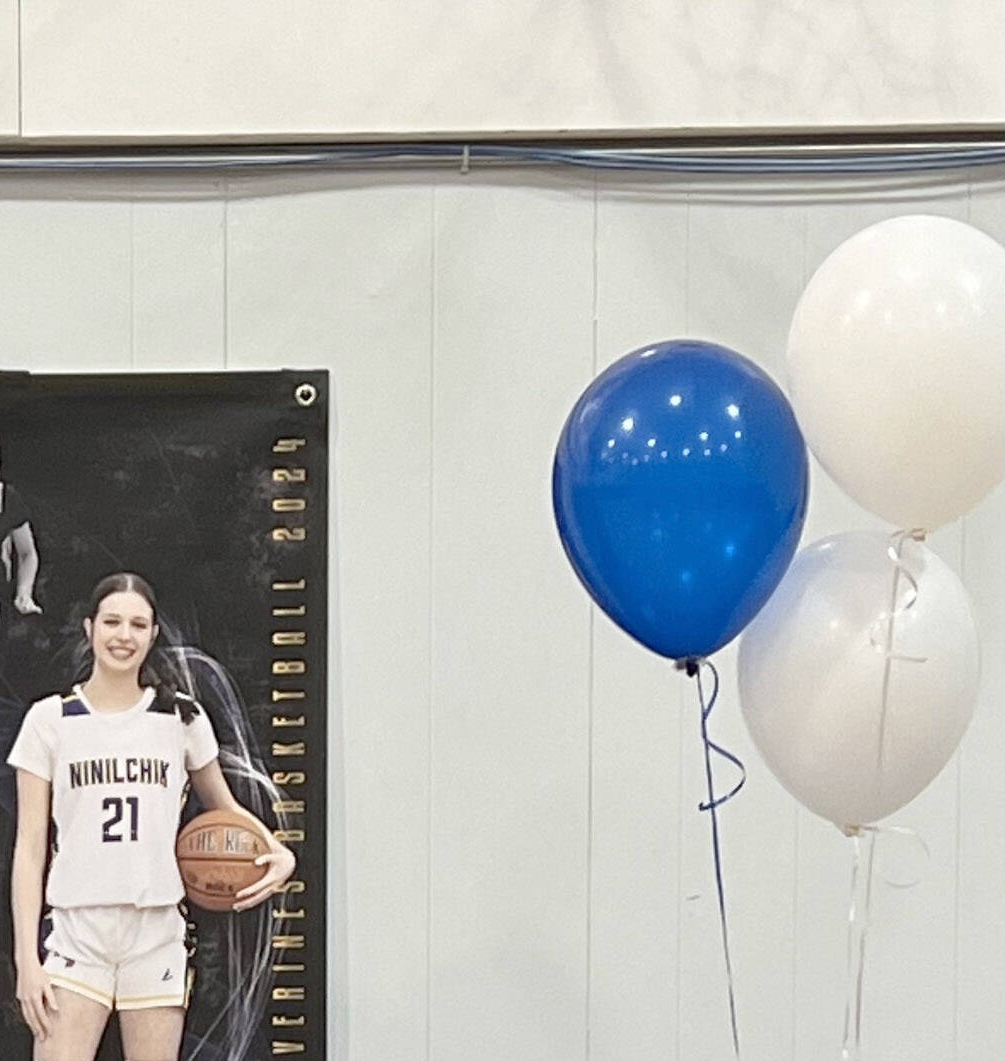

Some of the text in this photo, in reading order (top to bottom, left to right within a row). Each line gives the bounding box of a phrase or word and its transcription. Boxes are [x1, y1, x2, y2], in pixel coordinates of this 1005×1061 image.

[272, 438, 306, 541] 2024
[272, 577, 306, 842] BASKETBALL
[69, 758, 170, 789] NINILCHIK
[102, 797, 139, 842] 21
